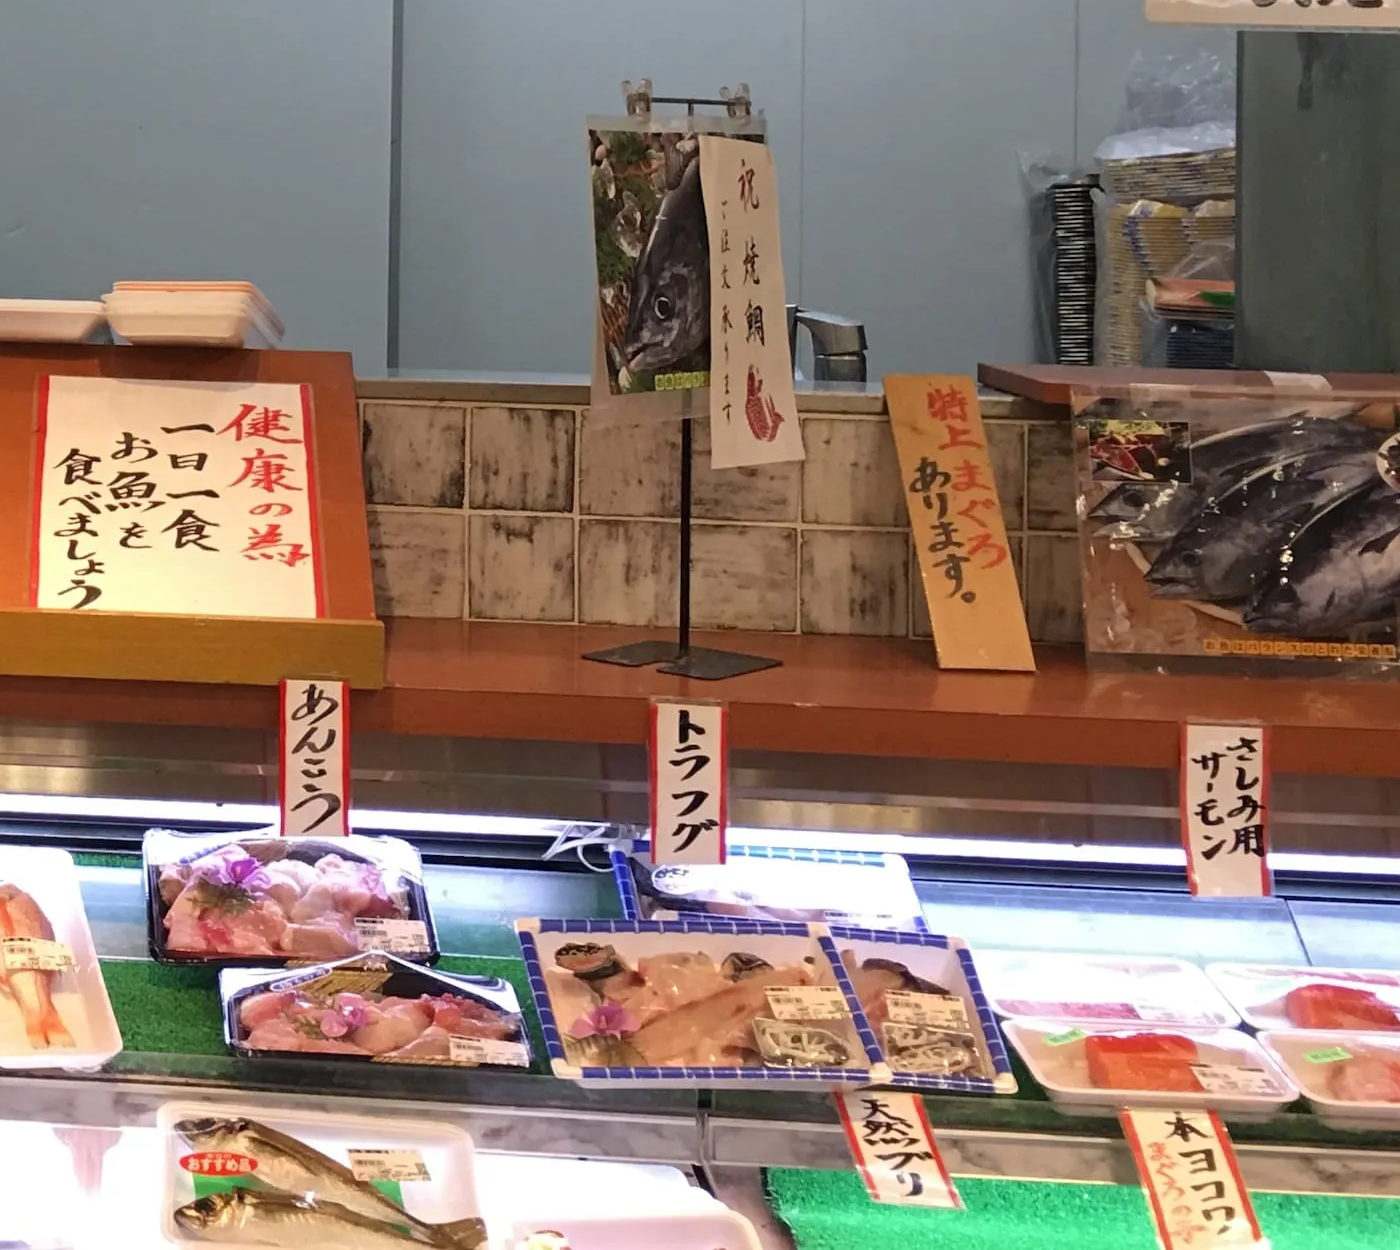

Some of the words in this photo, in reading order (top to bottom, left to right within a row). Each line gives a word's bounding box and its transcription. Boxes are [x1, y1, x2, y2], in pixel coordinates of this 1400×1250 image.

[53, 448, 105, 610] 食べましょう
[104, 432, 166, 548] お魚を
[160, 423, 220, 551] 一日一食
[216, 403, 311, 567] 健康の為
[909, 456, 976, 603] あります。
[927, 384, 1008, 569] 特上まぐろ
[290, 684, 341, 833] あんこう
[669, 710, 719, 853] トラフグ
[1191, 752, 1227, 860] サーモン
[1227, 737, 1266, 858] さしみ用
[860, 1098, 934, 1197] 天然ブリ
[1164, 1111, 1235, 1235] 本ヨコワ
